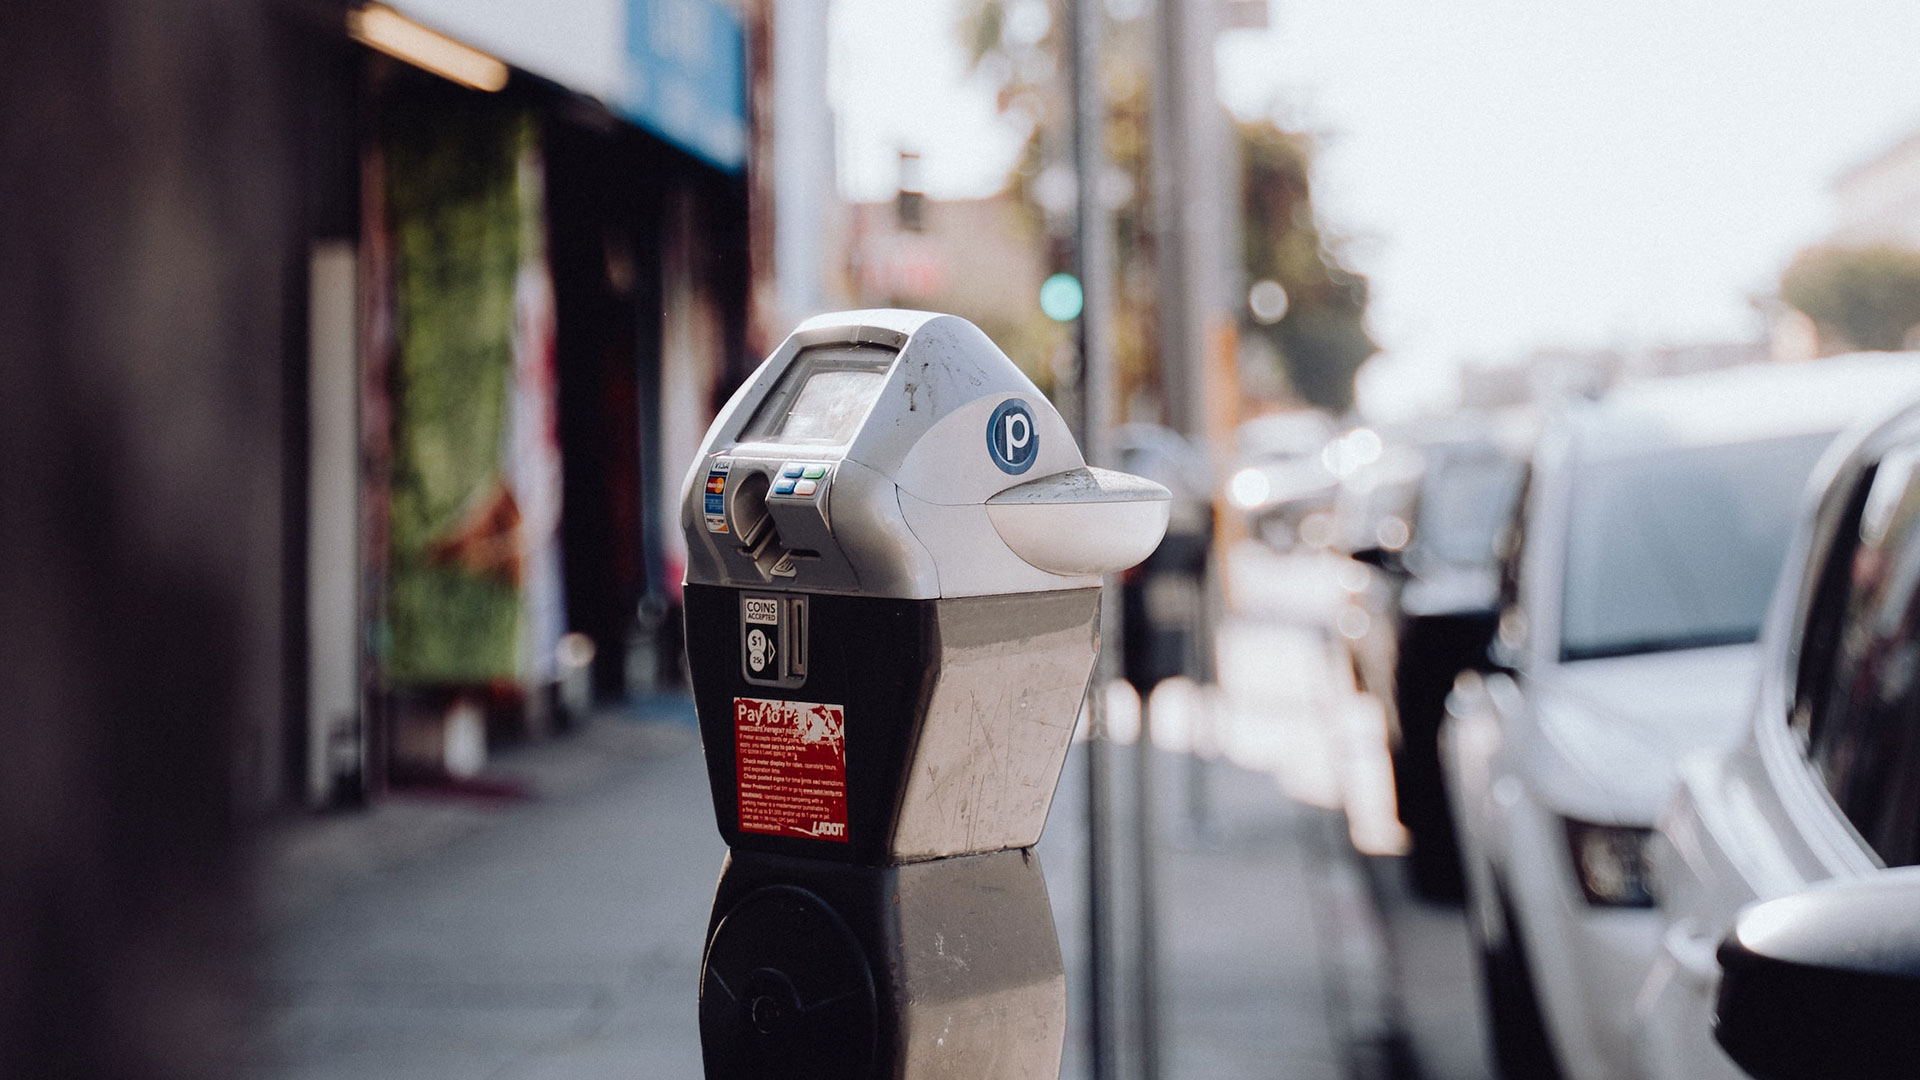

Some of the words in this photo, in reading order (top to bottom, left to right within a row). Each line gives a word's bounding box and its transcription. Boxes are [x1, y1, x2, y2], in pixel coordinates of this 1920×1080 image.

[747, 601, 776, 614] COINS
[748, 613, 776, 621] ACCEPTED
[738, 704, 761, 726] Pay
[767, 708, 780, 724] to
[812, 821, 845, 836] LADOT
